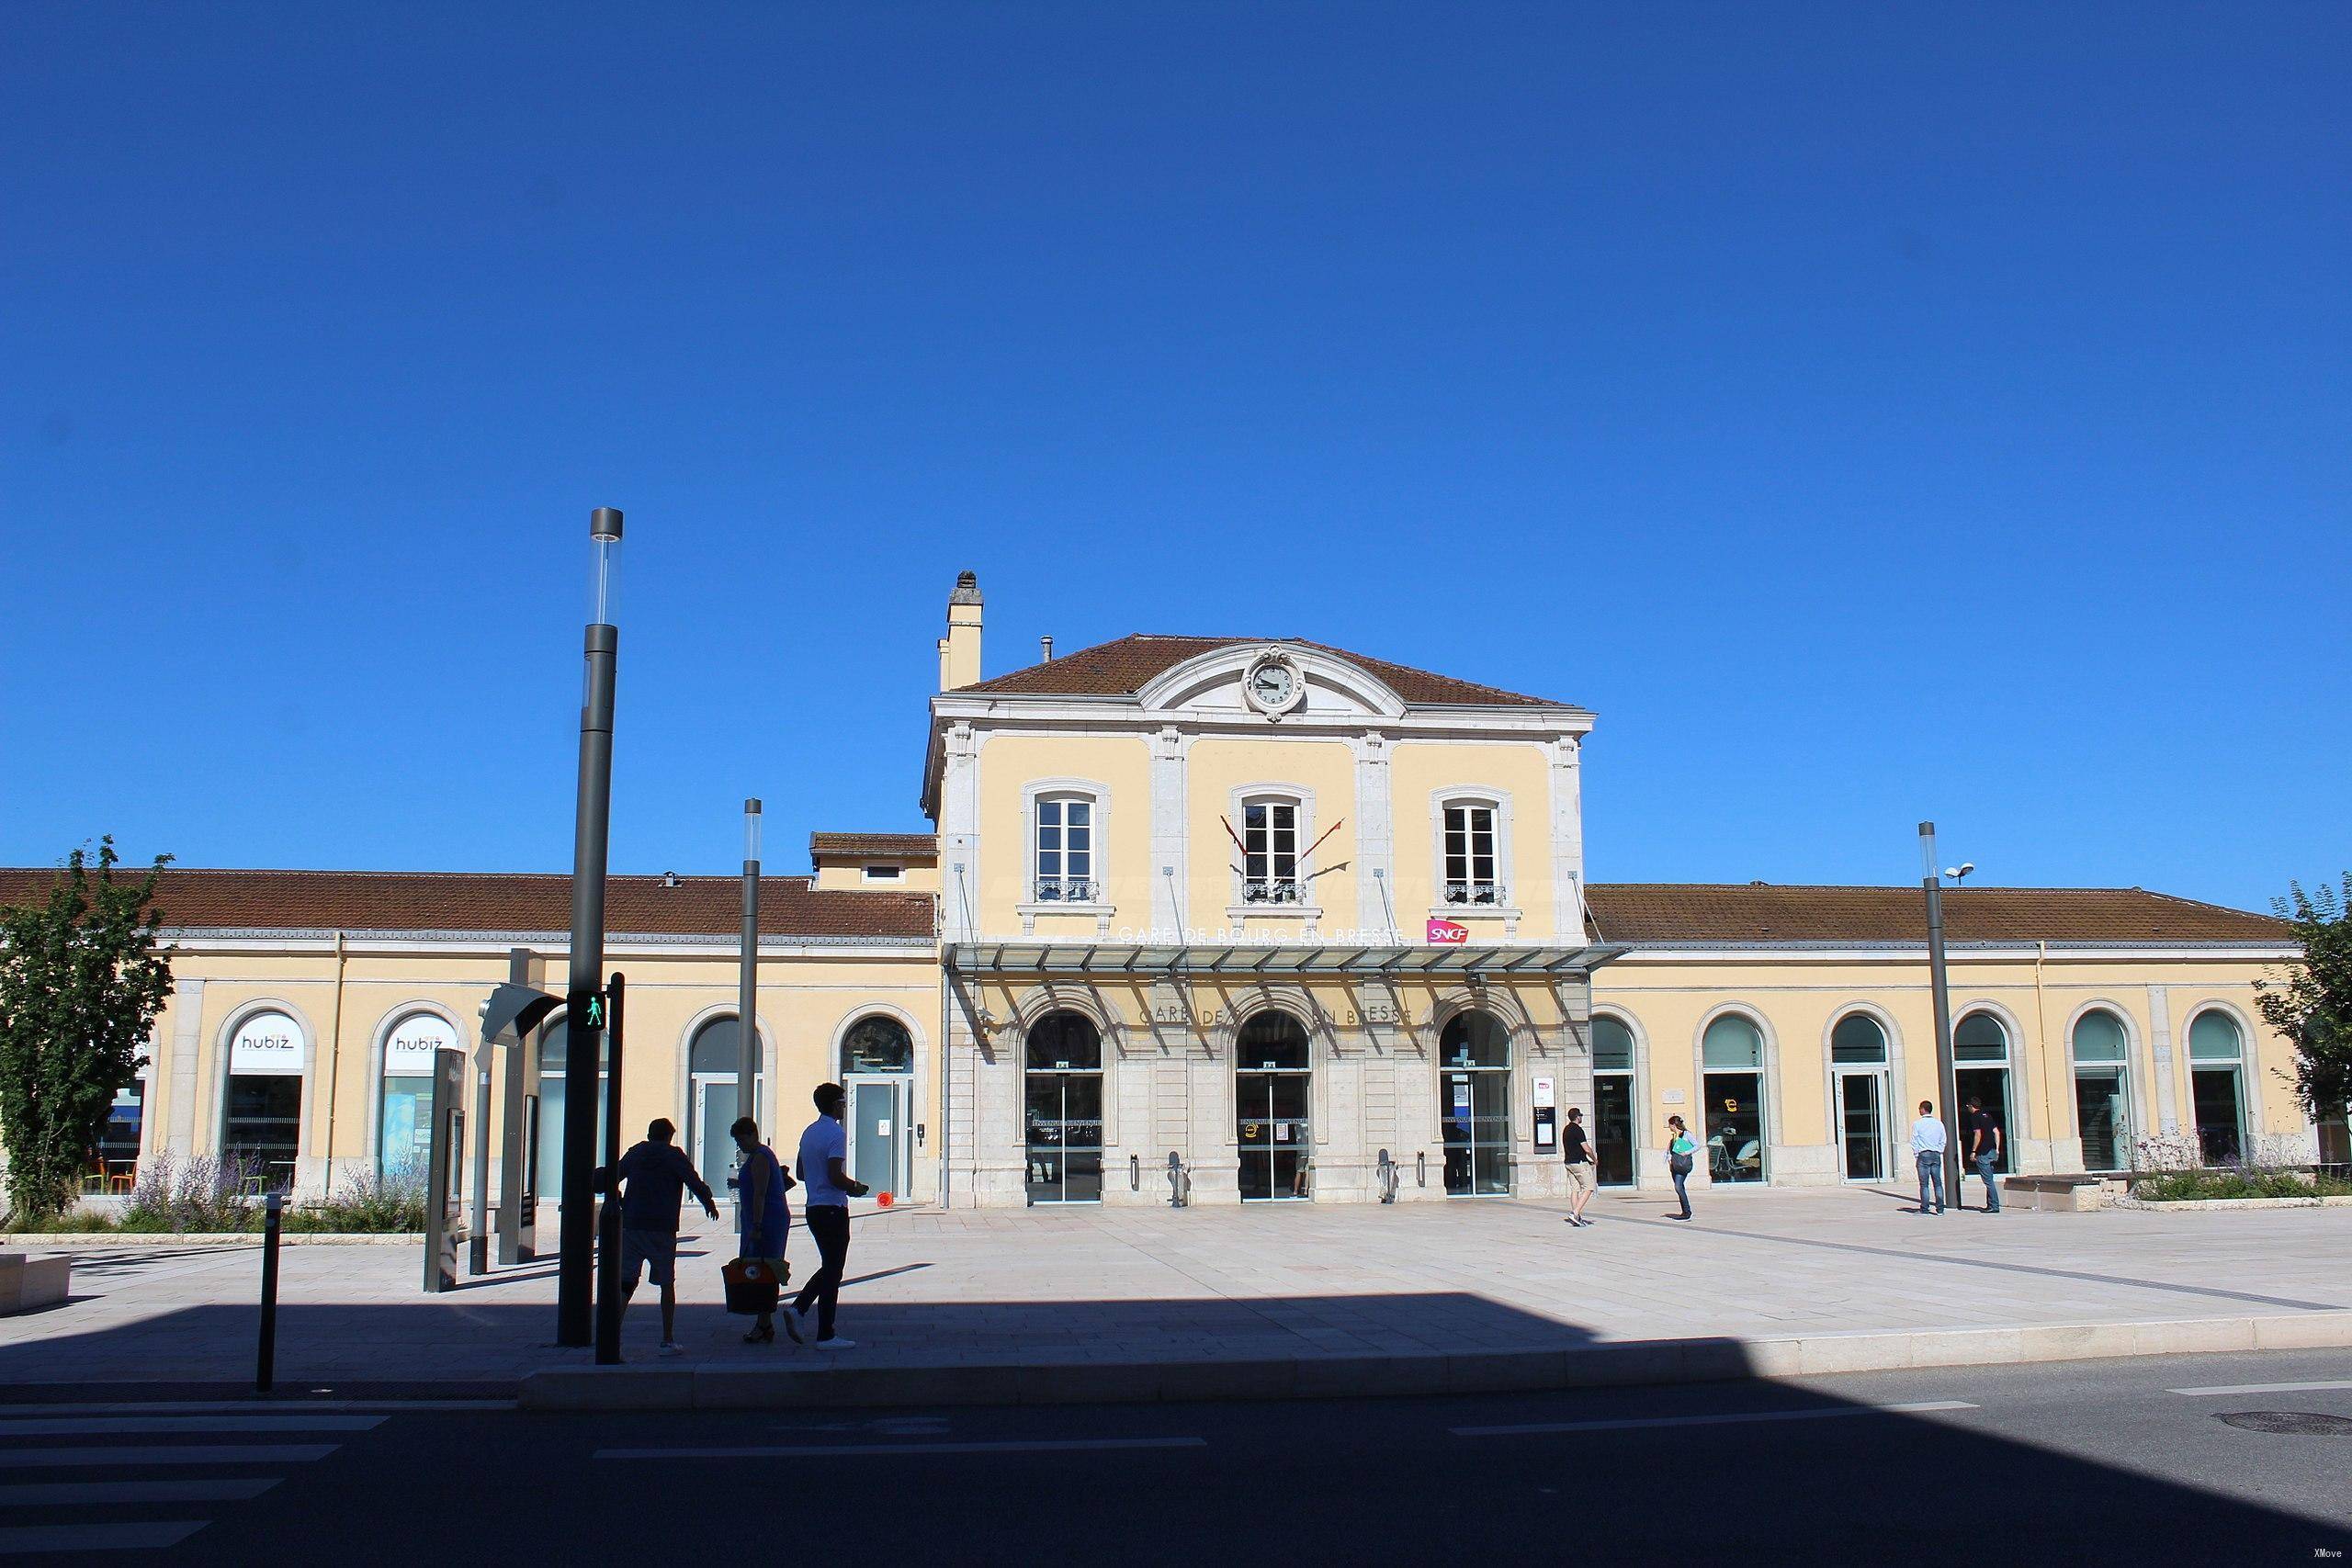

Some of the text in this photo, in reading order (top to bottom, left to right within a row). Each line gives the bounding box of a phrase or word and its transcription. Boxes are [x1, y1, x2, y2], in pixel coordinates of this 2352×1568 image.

[1118, 926, 1404, 943] GARE DE BOURG EN BRESSE
[1430, 929, 1467, 940] SNCF
[242, 1035, 294, 1049] hubiz
